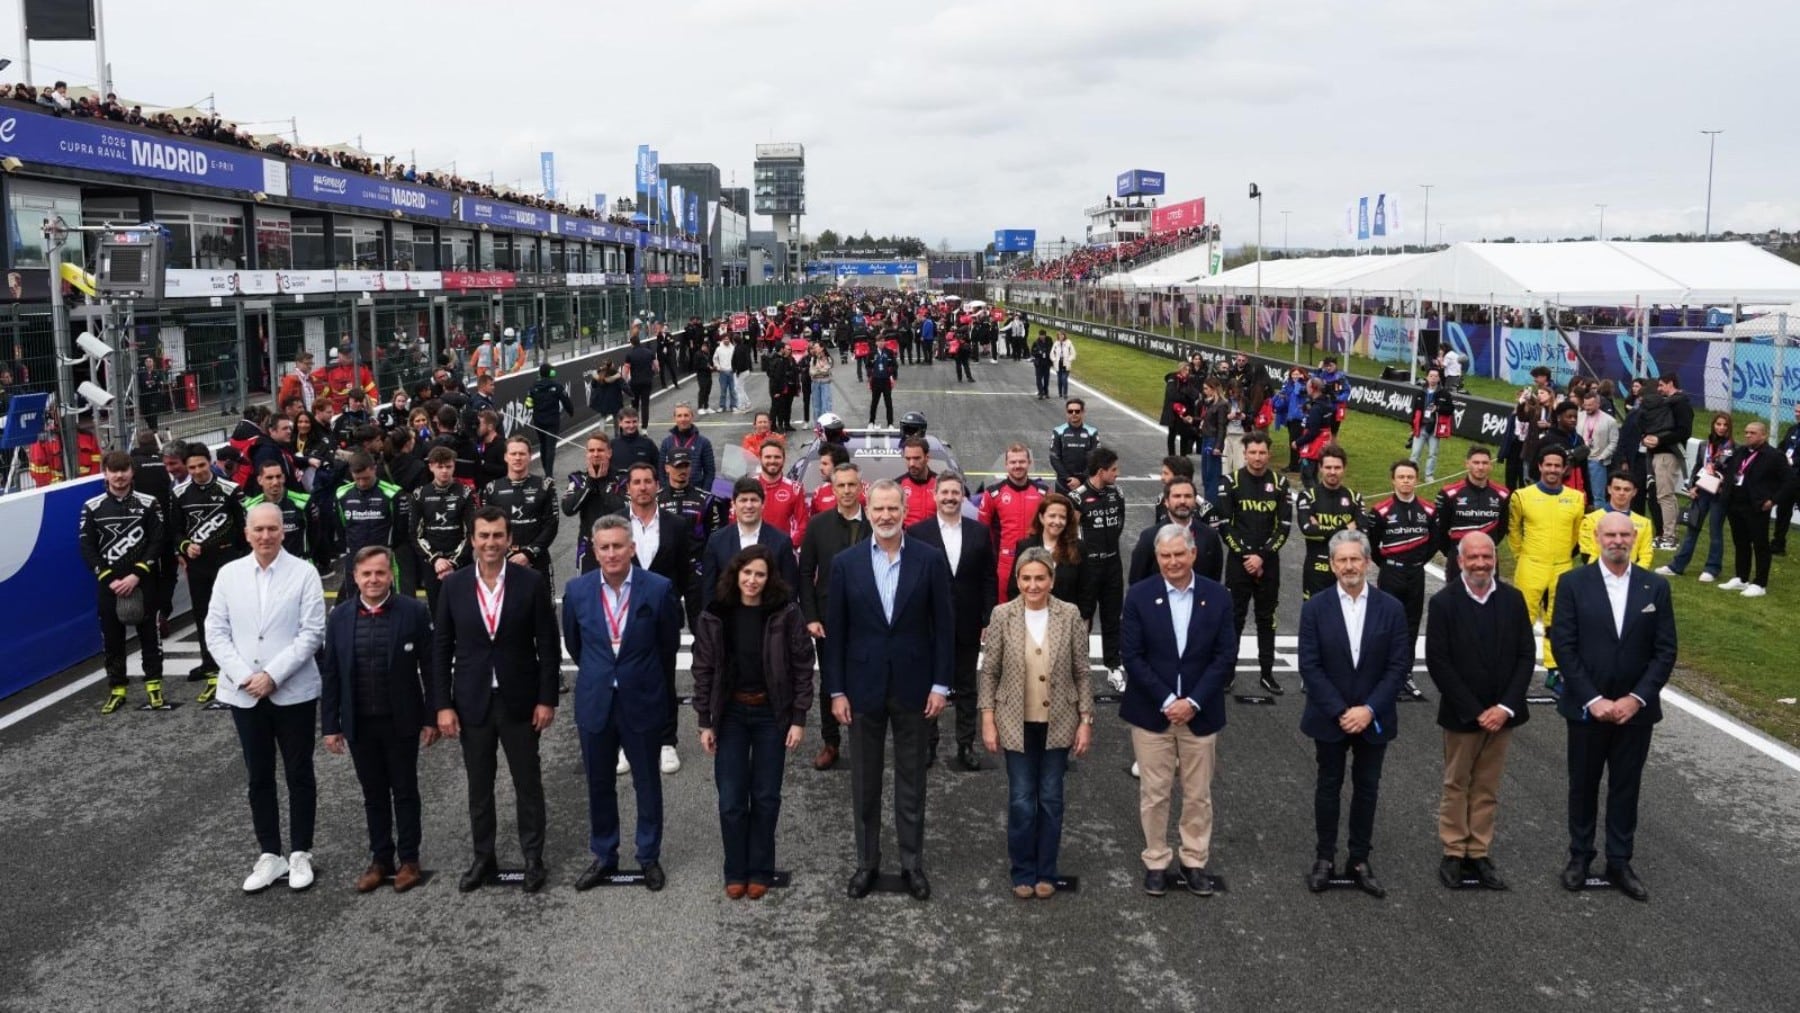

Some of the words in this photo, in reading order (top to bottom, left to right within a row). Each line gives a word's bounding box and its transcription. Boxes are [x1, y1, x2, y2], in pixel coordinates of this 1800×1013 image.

[59, 140, 94, 154] CUPRA
[97, 146, 127, 160] RAVAL
[101, 134, 126, 147] 2026
[131, 140, 208, 175] MADRID
[391, 187, 426, 209] MADRID
[1481, 413, 1507, 436] BEYO
[854, 448, 902, 457] Autoliv
